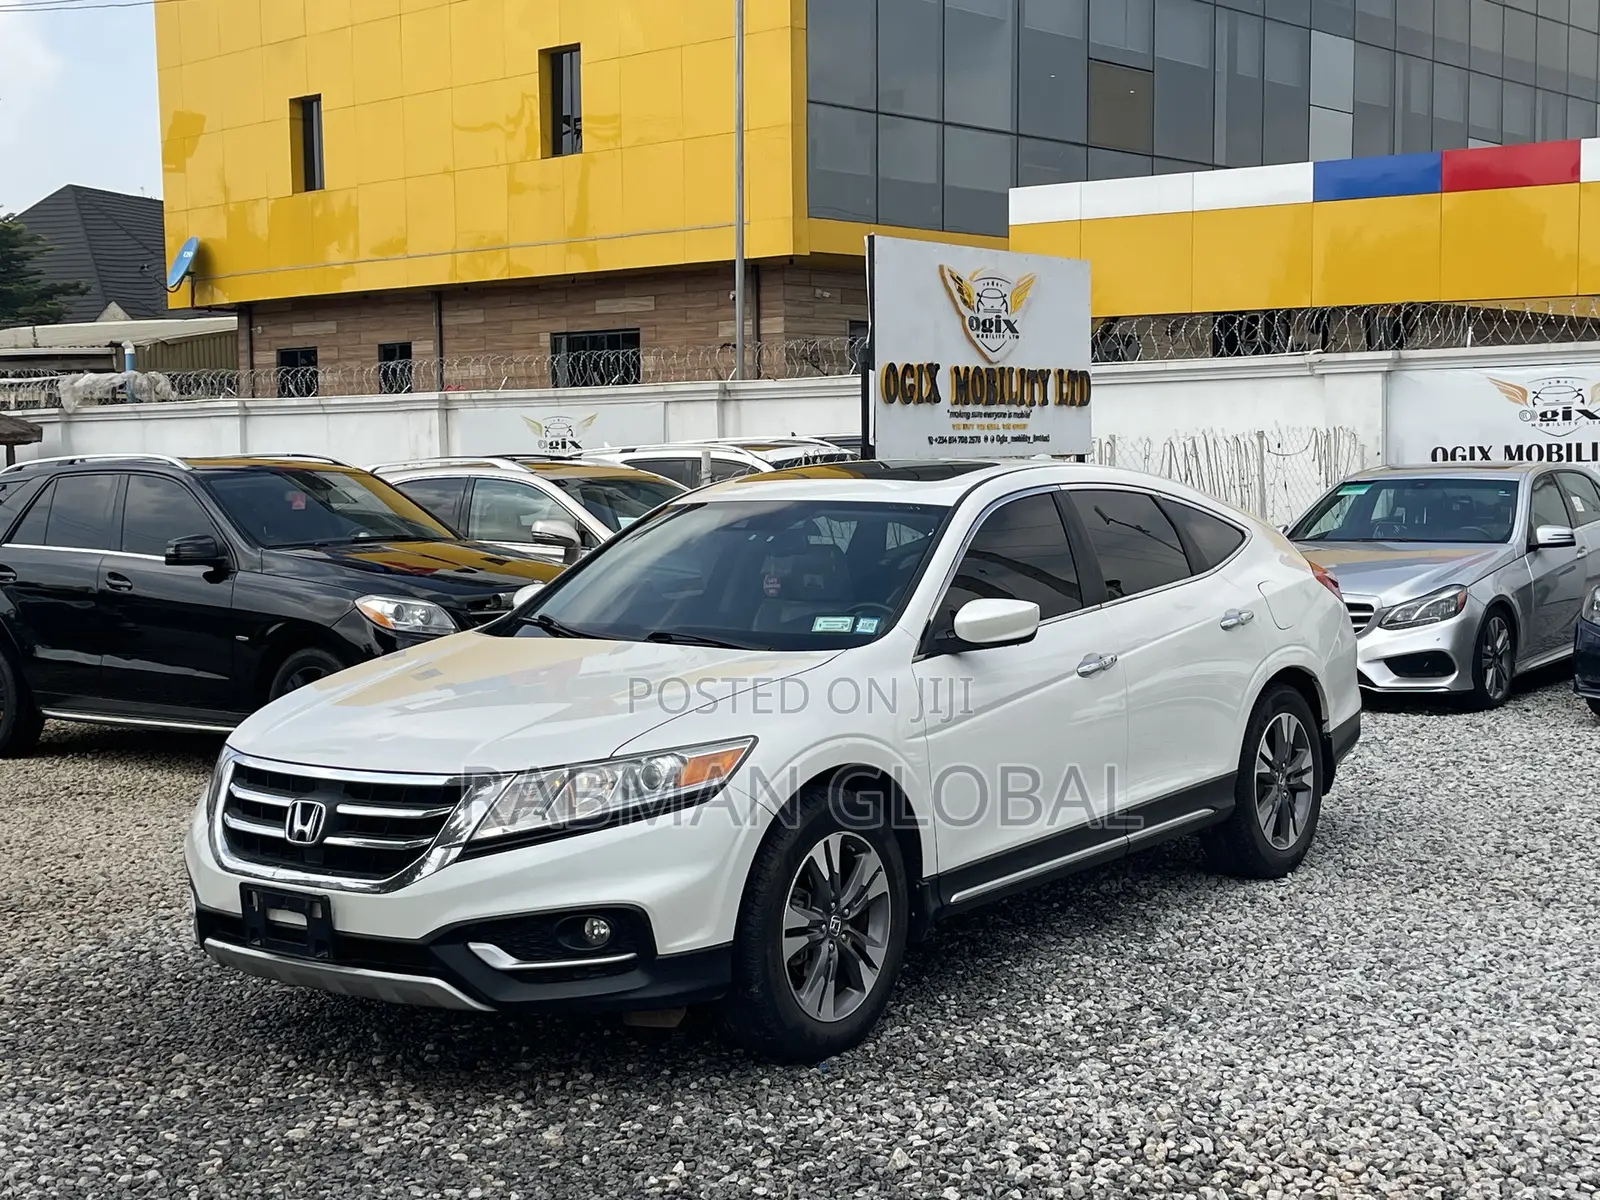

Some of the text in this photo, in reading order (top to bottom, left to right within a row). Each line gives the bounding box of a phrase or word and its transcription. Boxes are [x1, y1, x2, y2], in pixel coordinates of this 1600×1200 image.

[968, 315, 1019, 334] Ogix
[880, 361, 1091, 407] OGIX MOBILITY LTD
[1430, 442, 1600, 462] OGIX MOBILI
